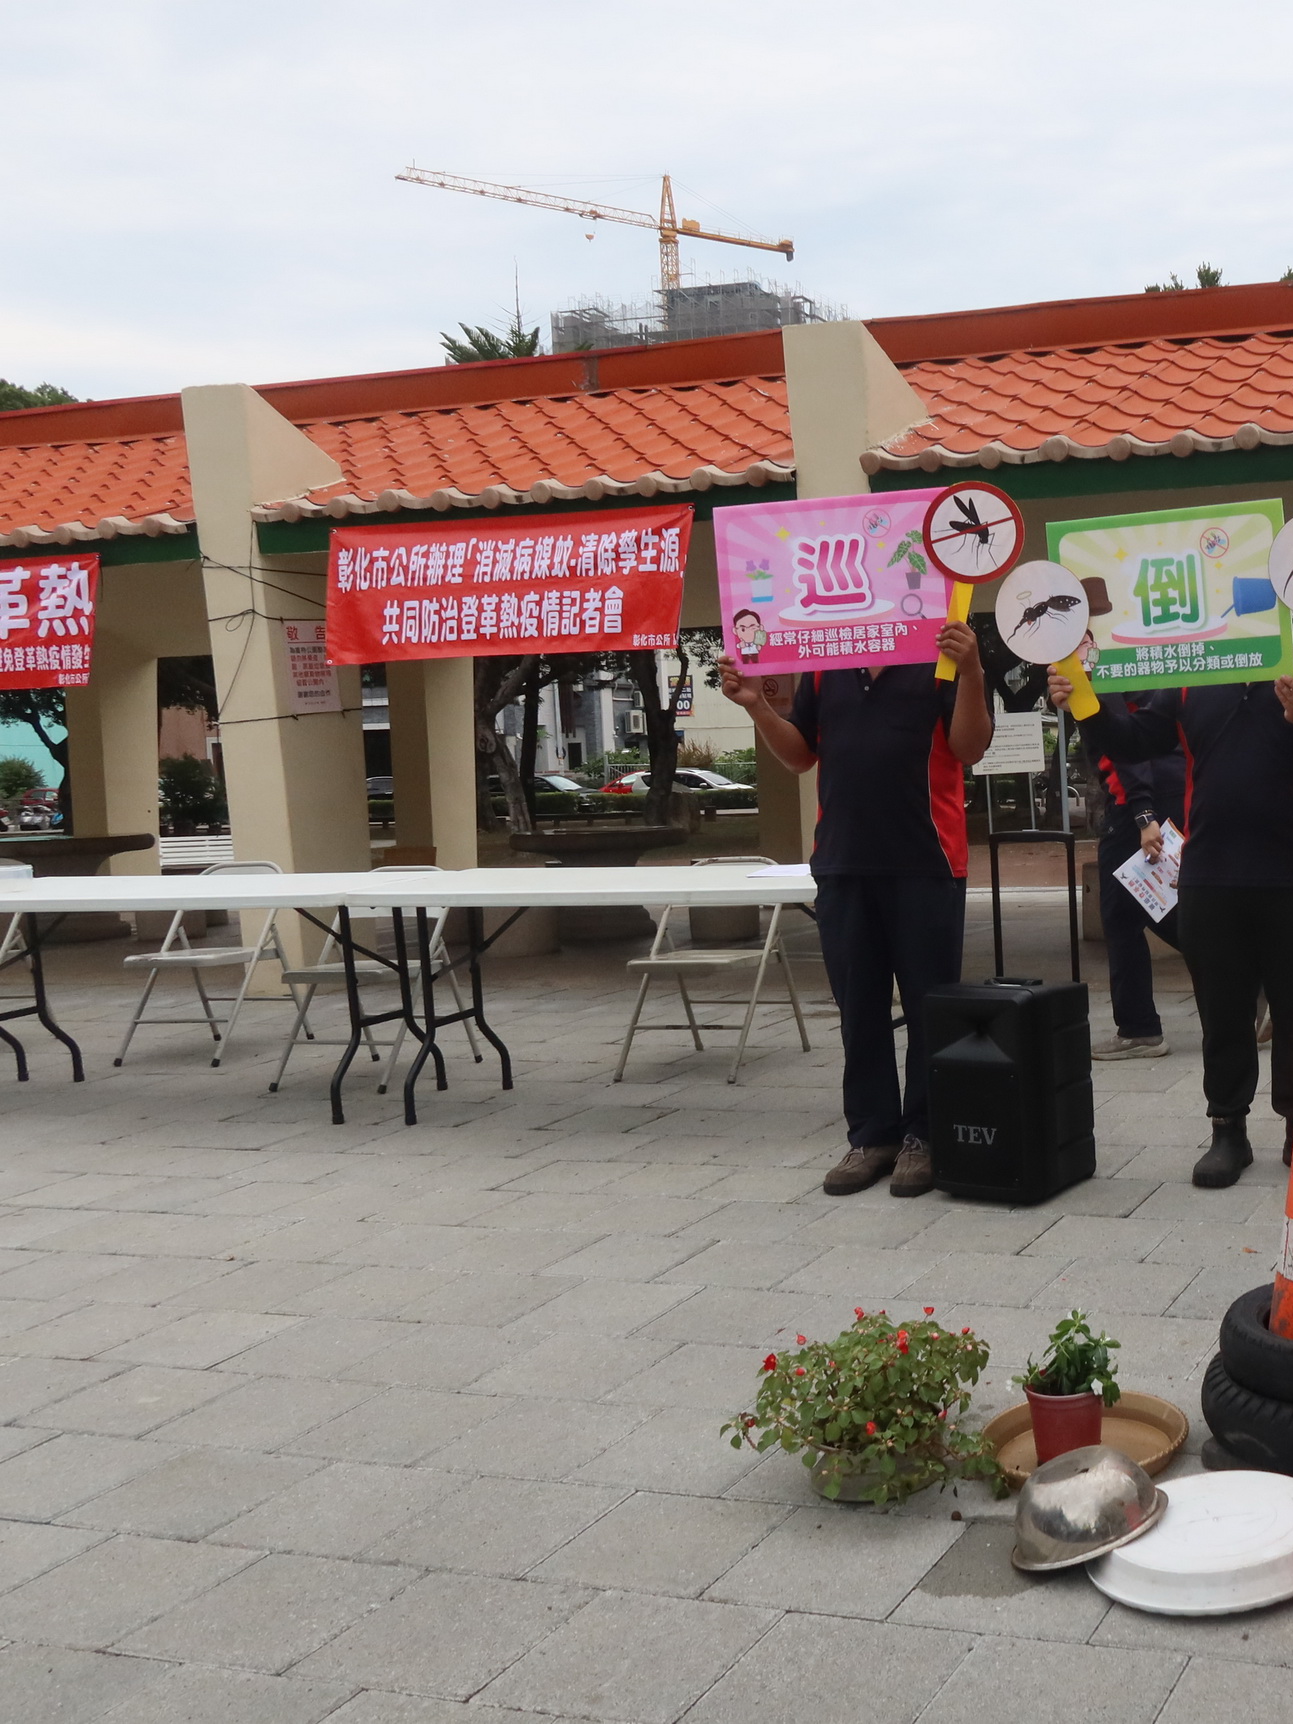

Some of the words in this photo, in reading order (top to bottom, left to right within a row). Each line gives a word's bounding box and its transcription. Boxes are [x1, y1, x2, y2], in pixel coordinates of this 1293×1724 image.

[796, 535, 872, 612] 巡
[1133, 553, 1200, 628] 倒
[382, 585, 624, 645] 共同防治登革熱疫情記者會
[633, 634, 671, 647] 彰化市公所
[798, 638, 896, 659] 外可能積水容器
[1096, 652, 1263, 679] 不要的器物予以分類或倒放
[953, 1124, 997, 1146] TEV
